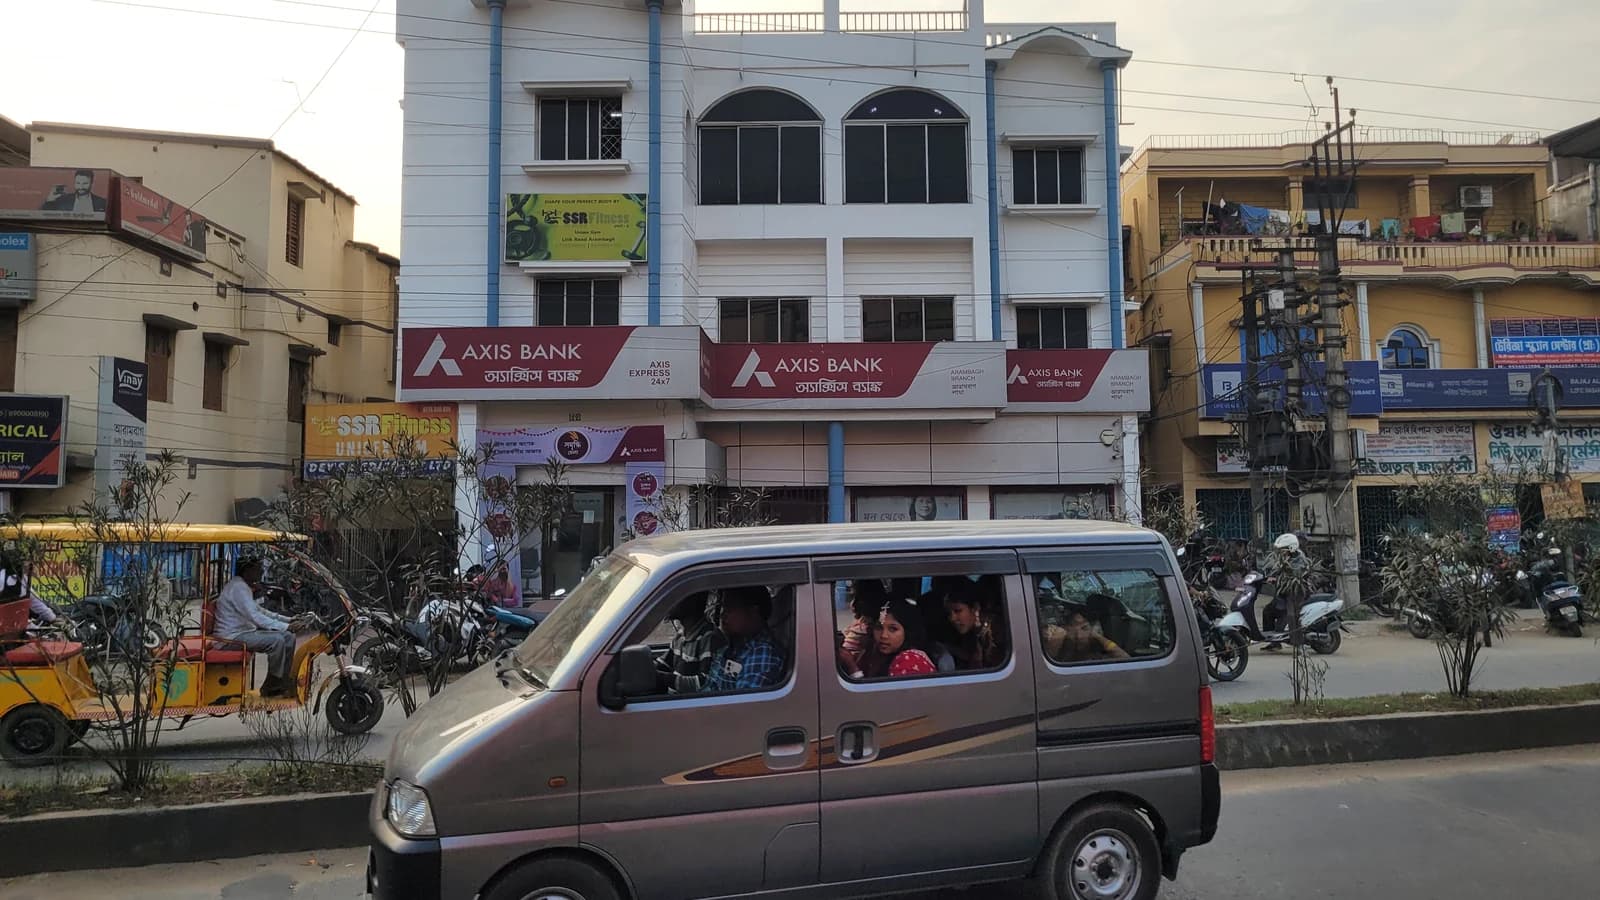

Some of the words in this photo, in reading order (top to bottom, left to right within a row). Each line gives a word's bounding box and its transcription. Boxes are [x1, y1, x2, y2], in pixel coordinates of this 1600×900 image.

[562, 212, 588, 224] SSR
[0, 236, 26, 246] olex
[461, 344, 511, 360] AXIS
[520, 343, 582, 360] BANK
[775, 358, 819, 373] AXIS
[827, 358, 883, 372] BANK
[484, 367, 542, 382] অ্যাক্সিস
[795, 379, 847, 393] অ্যাক্সিস
[337, 414, 380, 436] SSR
[380, 412, 452, 436] Fitness
[1514, 444, 1542, 462] অতু
[429, 460, 451, 471] LTD
